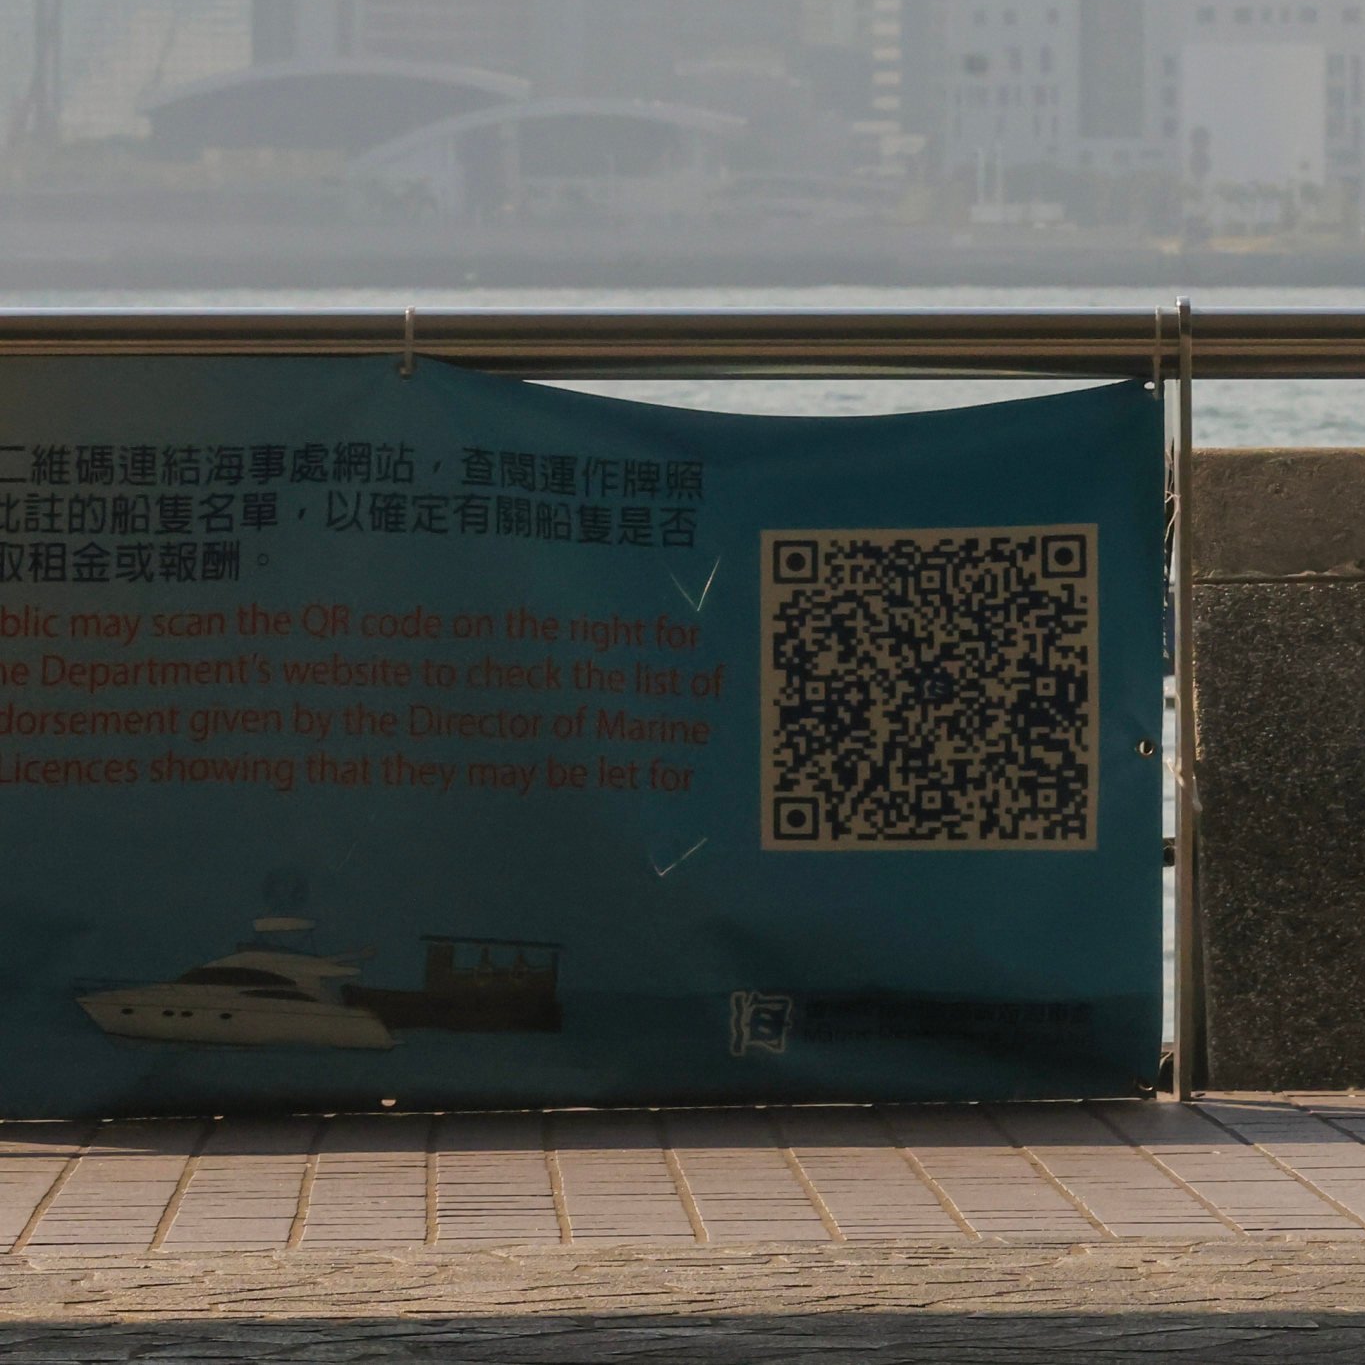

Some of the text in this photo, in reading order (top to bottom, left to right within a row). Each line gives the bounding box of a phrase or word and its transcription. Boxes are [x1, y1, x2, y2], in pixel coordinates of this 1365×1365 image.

[71, 612, 141, 647] may
[152, 612, 226, 638] scan
[237, 602, 291, 637] the
[303, 605, 351, 640] QR
[361, 605, 441, 640] code
[453, 613, 493, 639] on
[505, 607, 559, 642] the
[570, 614, 646, 652] right
[656, 615, 701, 650] for
[43, 653, 272, 694] Department's
[283, 653, 411, 688] website
[422, 661, 457, 688] to
[466, 657, 561, 690] check
[574, 660, 625, 693] the
[635, 660, 681, 696] list
[690, 664, 726, 700] of
[189, 706, 282, 742] given
[293, 702, 332, 742] by
[343, 701, 398, 736] the
[408, 704, 542, 739] Director
[553, 706, 588, 739] of
[596, 709, 712, 746] Marine
[150, 749, 294, 792] showing
[306, 749, 370, 785] that
[382, 753, 457, 793] they
[468, 761, 538, 795] may
[546, 755, 588, 789] be
[600, 756, 640, 791] let
[650, 759, 696, 793] for
